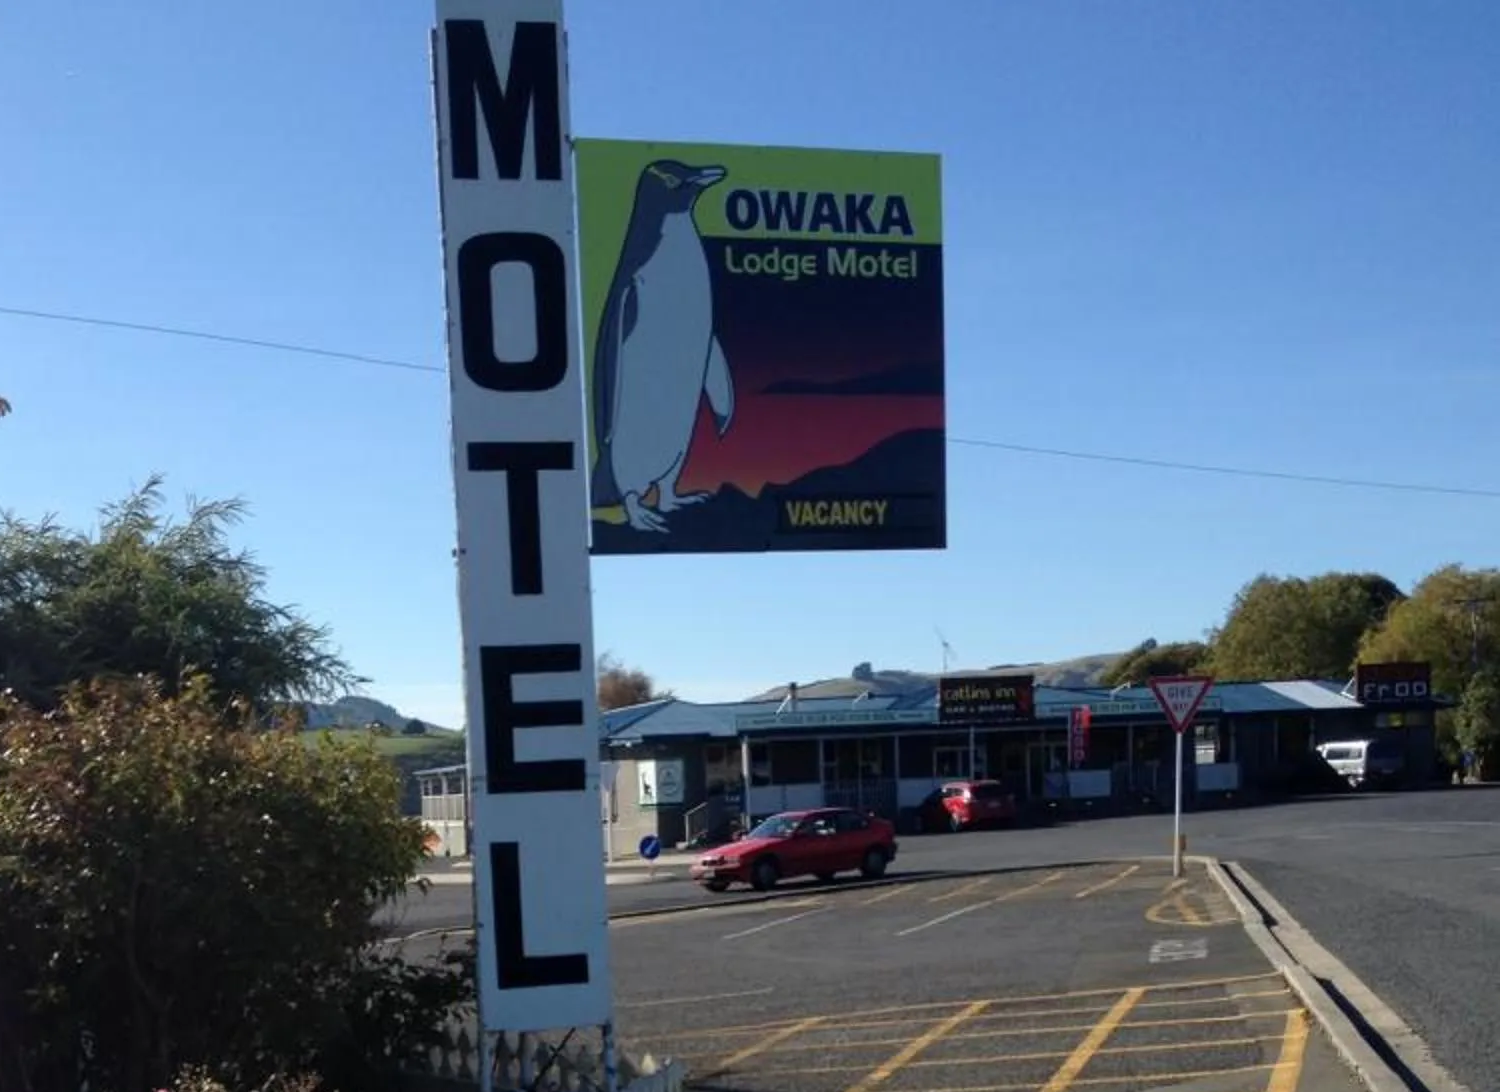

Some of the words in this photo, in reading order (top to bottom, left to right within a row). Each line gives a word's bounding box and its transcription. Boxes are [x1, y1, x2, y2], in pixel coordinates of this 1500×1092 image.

[724, 188, 914, 237] OWAKA
[724, 246, 817, 281] Lodge
[827, 246, 918, 280] Motel
[445, 19, 589, 989] MOTEL
[785, 499, 889, 526] VACANCY
[1167, 686, 1195, 699] GIVE
